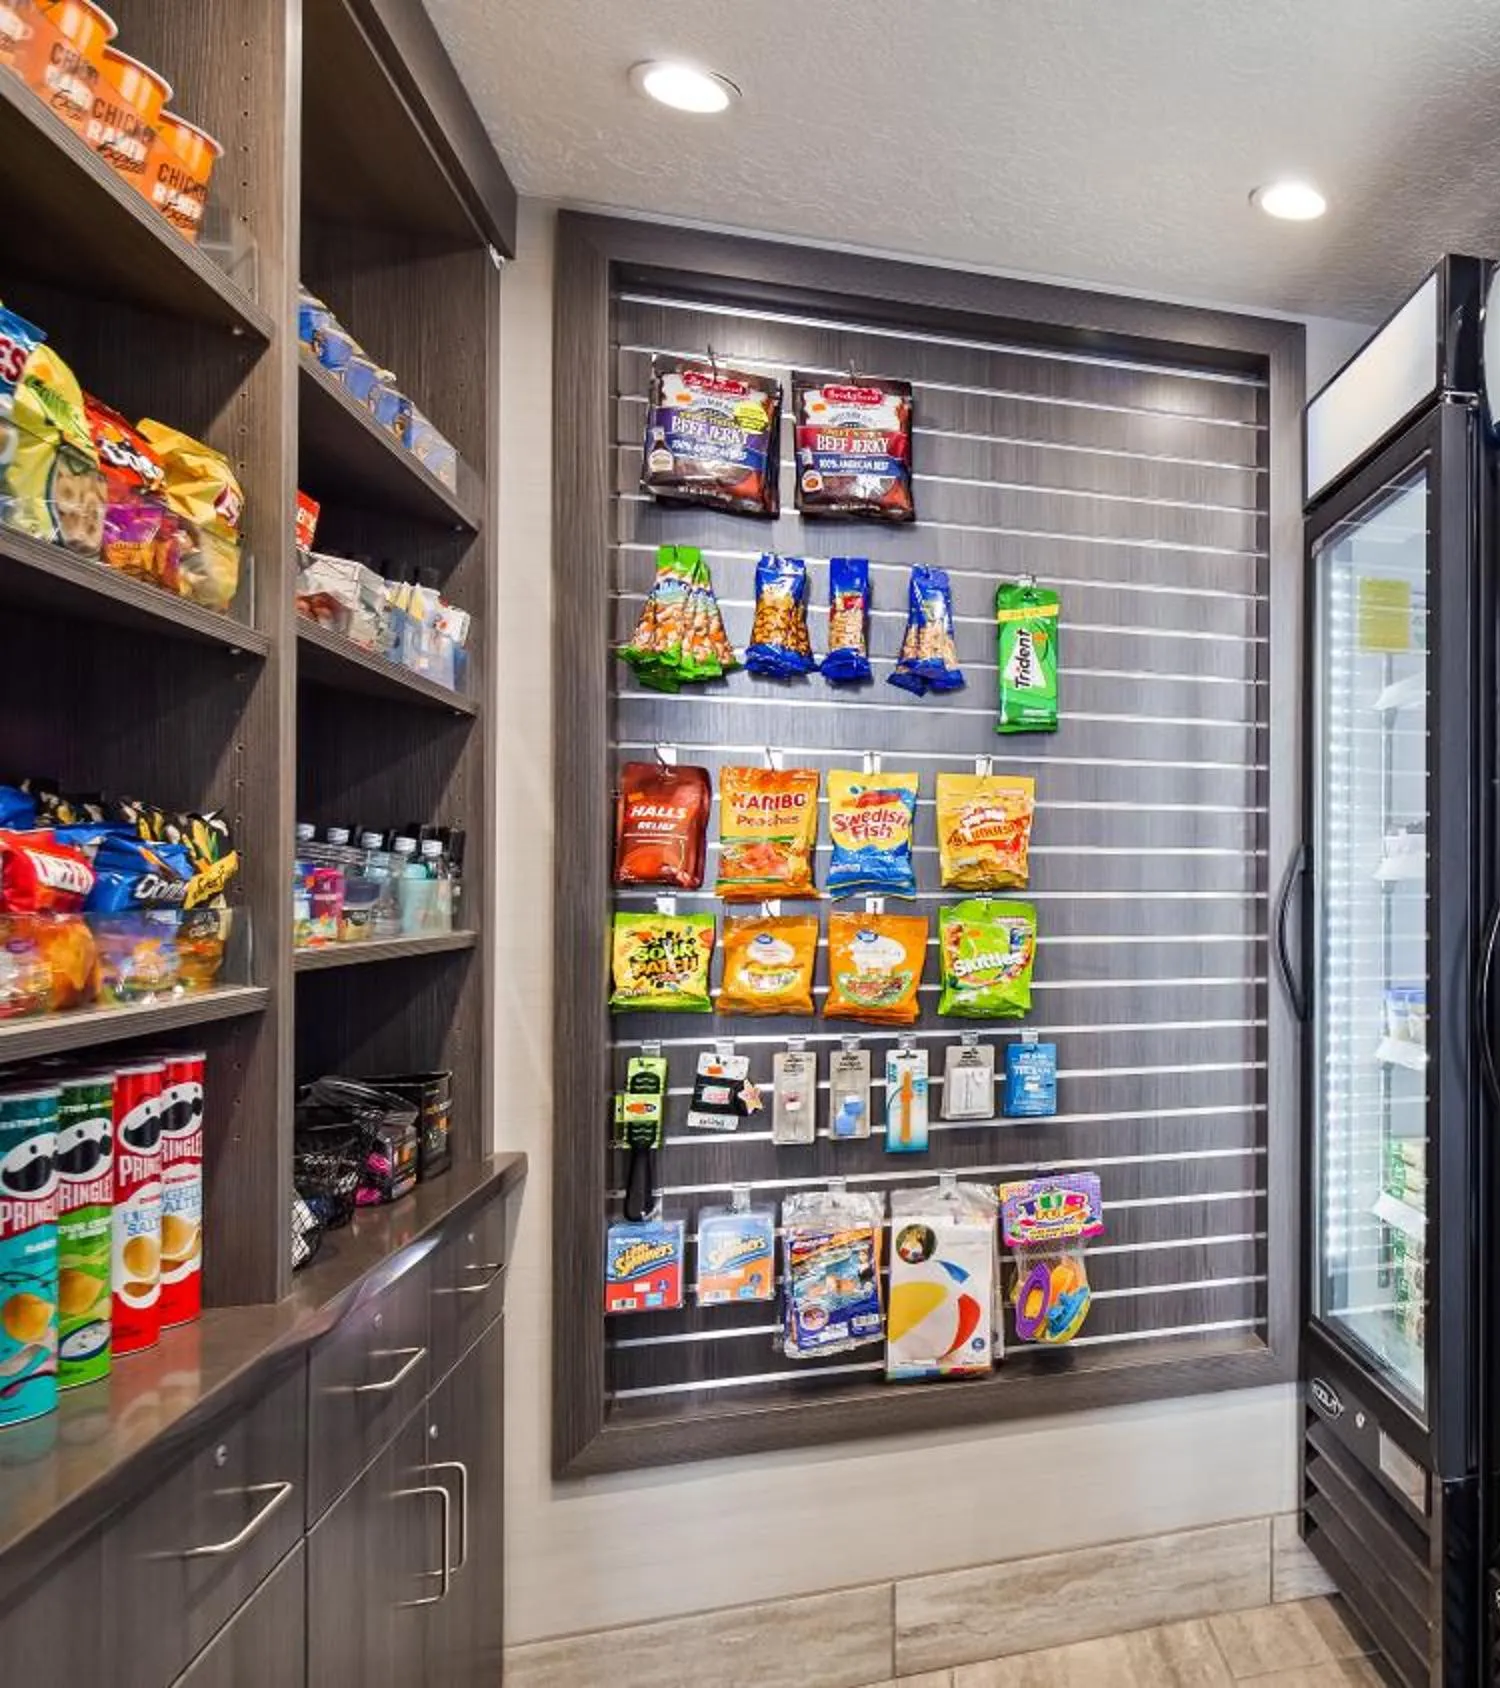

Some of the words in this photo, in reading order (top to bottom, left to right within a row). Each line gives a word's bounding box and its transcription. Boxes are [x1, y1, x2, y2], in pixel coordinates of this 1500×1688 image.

[672, 415, 708, 439] BEEF
[708, 424, 750, 446] JERKY
[816, 432, 849, 452] BEEF
[849, 436, 890, 454] JERKY
[1014, 628, 1031, 689] Trident
[629, 804, 689, 820] HALLS
[735, 814, 800, 829] Peaches
[832, 809, 911, 834] Swedish
[849, 823, 894, 842] Fish
[632, 941, 697, 962] SOUR
[953, 951, 1023, 977] Skittles
[161, 1130, 203, 1164] RINGLE
[58, 1172, 114, 1213] RINGLE
[0, 1198, 57, 1238] PRING
